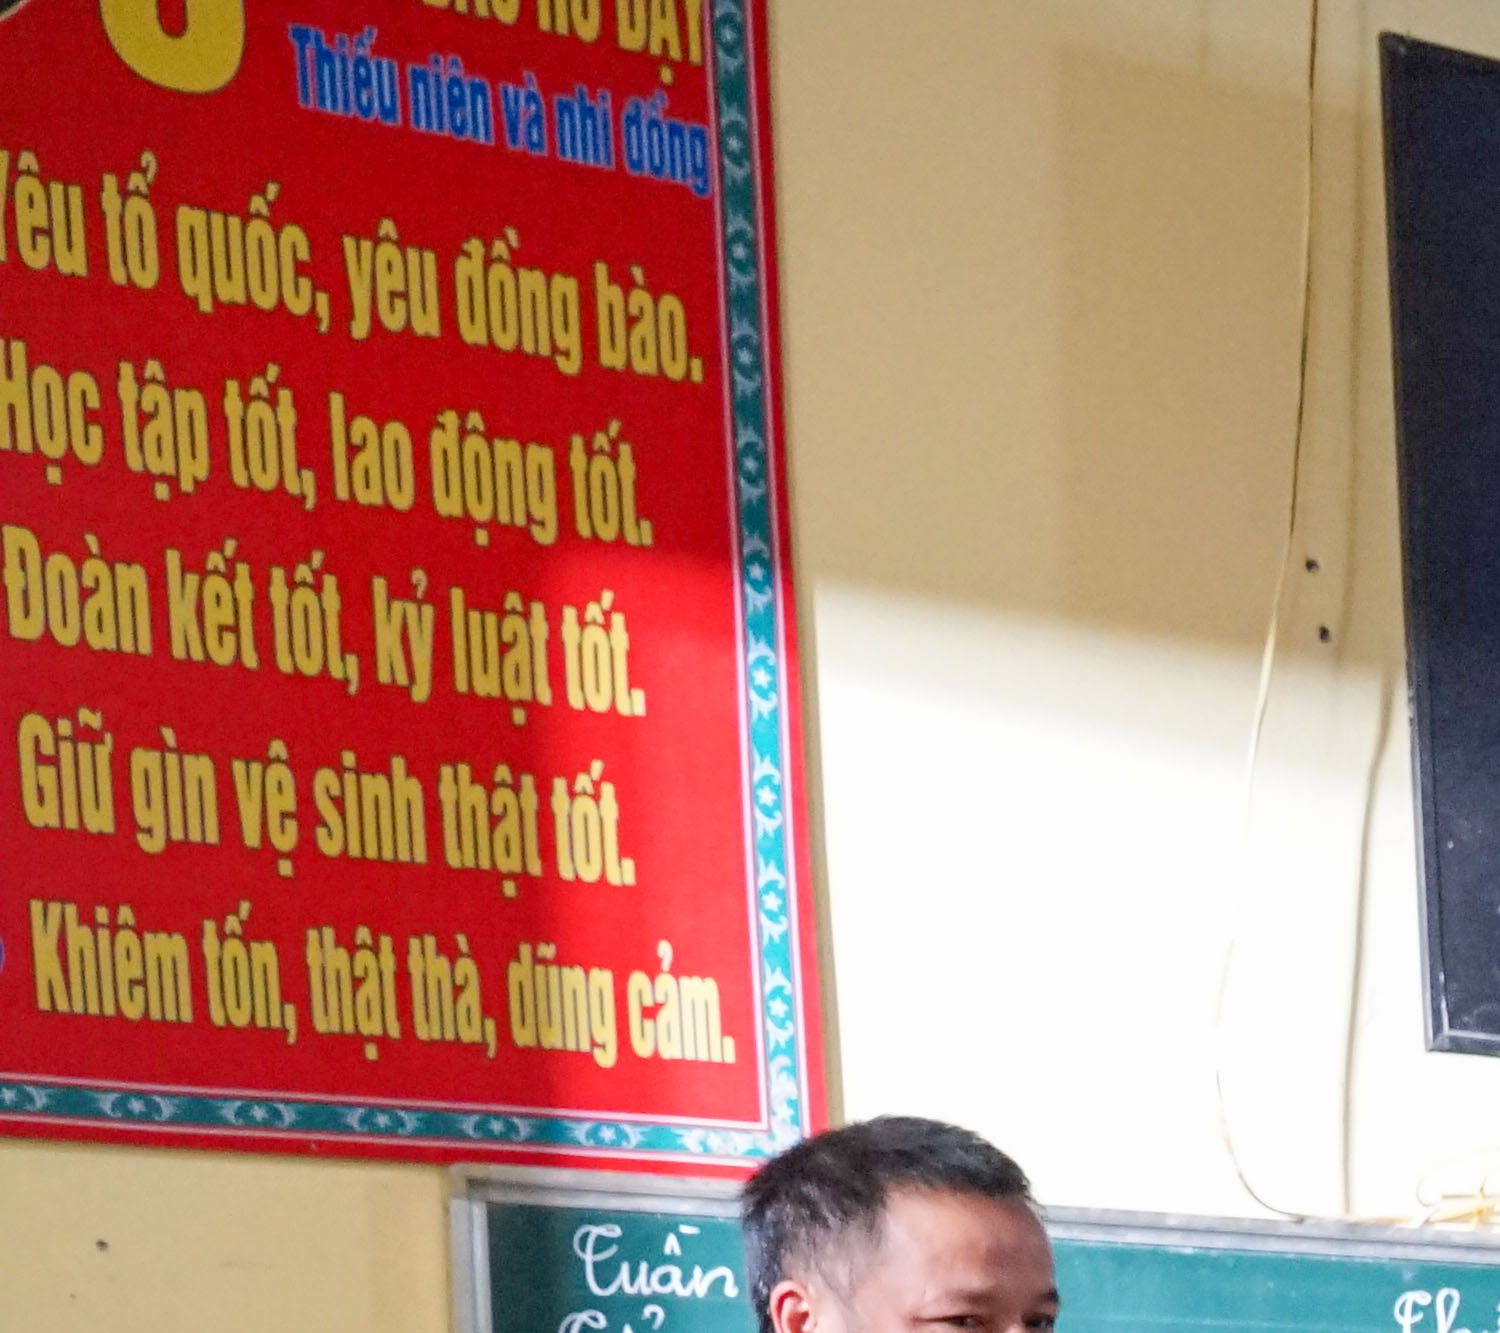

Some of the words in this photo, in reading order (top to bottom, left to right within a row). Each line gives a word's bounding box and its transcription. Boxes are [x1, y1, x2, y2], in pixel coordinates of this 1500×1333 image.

[290, 26, 399, 123] Thiếu
[409, 56, 492, 142] niên
[501, 76, 545, 152] và
[556, 87, 612, 166] nhi
[623, 93, 710, 197] đồng
[102, 152, 158, 288] tổ
[177, 182, 329, 331] quốc,
[344, 219, 440, 339] yêu
[455, 228, 581, 373] đồng
[595, 262, 702, 381] bào.
[0, 340, 103, 484] Học
[119, 361, 210, 499] tập
[224, 364, 314, 509] tốt,
[330, 393, 413, 510] lao
[431, 410, 557, 544] động
[569, 421, 651, 545] tốt.
[3, 526, 150, 654] Đoàn
[166, 539, 258, 668] kết
[270, 551, 358, 692] tốt,
[372, 570, 433, 701] kỷ
[451, 587, 550, 724] luật
[563, 592, 644, 714] tốt.
[19, 708, 114, 833] Giữ
[131, 728, 218, 852] gìn
[232, 740, 296, 876] vệ
[315, 751, 426, 862] sinh
[439, 763, 540, 897] thật
[552, 762, 634, 884] tốt.
[30, 900, 191, 1021] Khiêm
[204, 901, 296, 1040] tốn,
[306, 926, 399, 1058] thật
[408, 935, 495, 1056] thà,
[508, 944, 616, 1066] dũng
[628, 942, 734, 1062] cảm.
